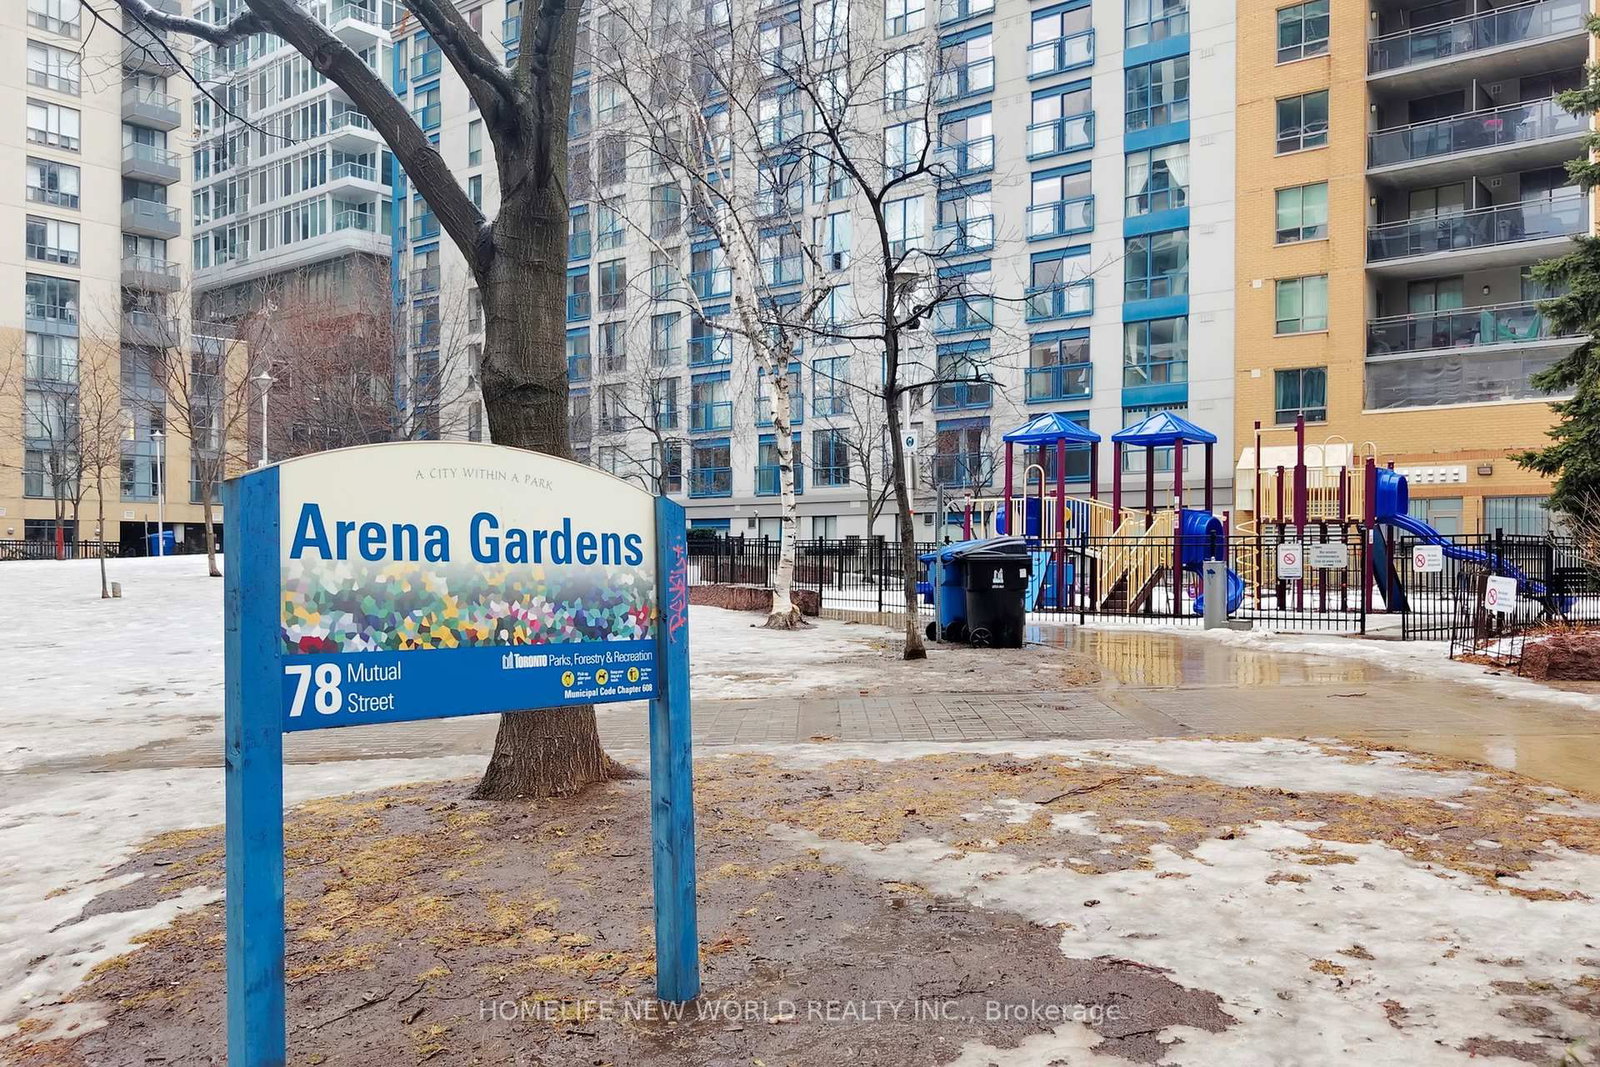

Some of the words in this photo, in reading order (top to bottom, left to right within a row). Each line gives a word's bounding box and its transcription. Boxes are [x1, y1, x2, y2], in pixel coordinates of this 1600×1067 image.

[415, 469, 425, 480] A
[429, 467, 457, 479] CITY
[462, 467, 507, 481] WITHIN
[511, 473, 520, 483] A
[524, 474, 553, 491] PARK
[289, 502, 450, 562] Arena
[469, 511, 644, 566] Gardens
[513, 653, 548, 669] TORONTO
[549, 653, 573, 667] Parks,
[574, 652, 606, 666] Forestry
[606, 651, 613, 663] &
[613, 649, 653, 663] Recreation
[347, 660, 401, 683] Mutual
[284, 663, 343, 718] 78
[564, 687, 599, 699] Municipal
[600, 686, 616, 696] Code
[617, 685, 641, 696] Chapter
[642, 683, 653, 693] 608
[348, 692, 395, 713] Street
